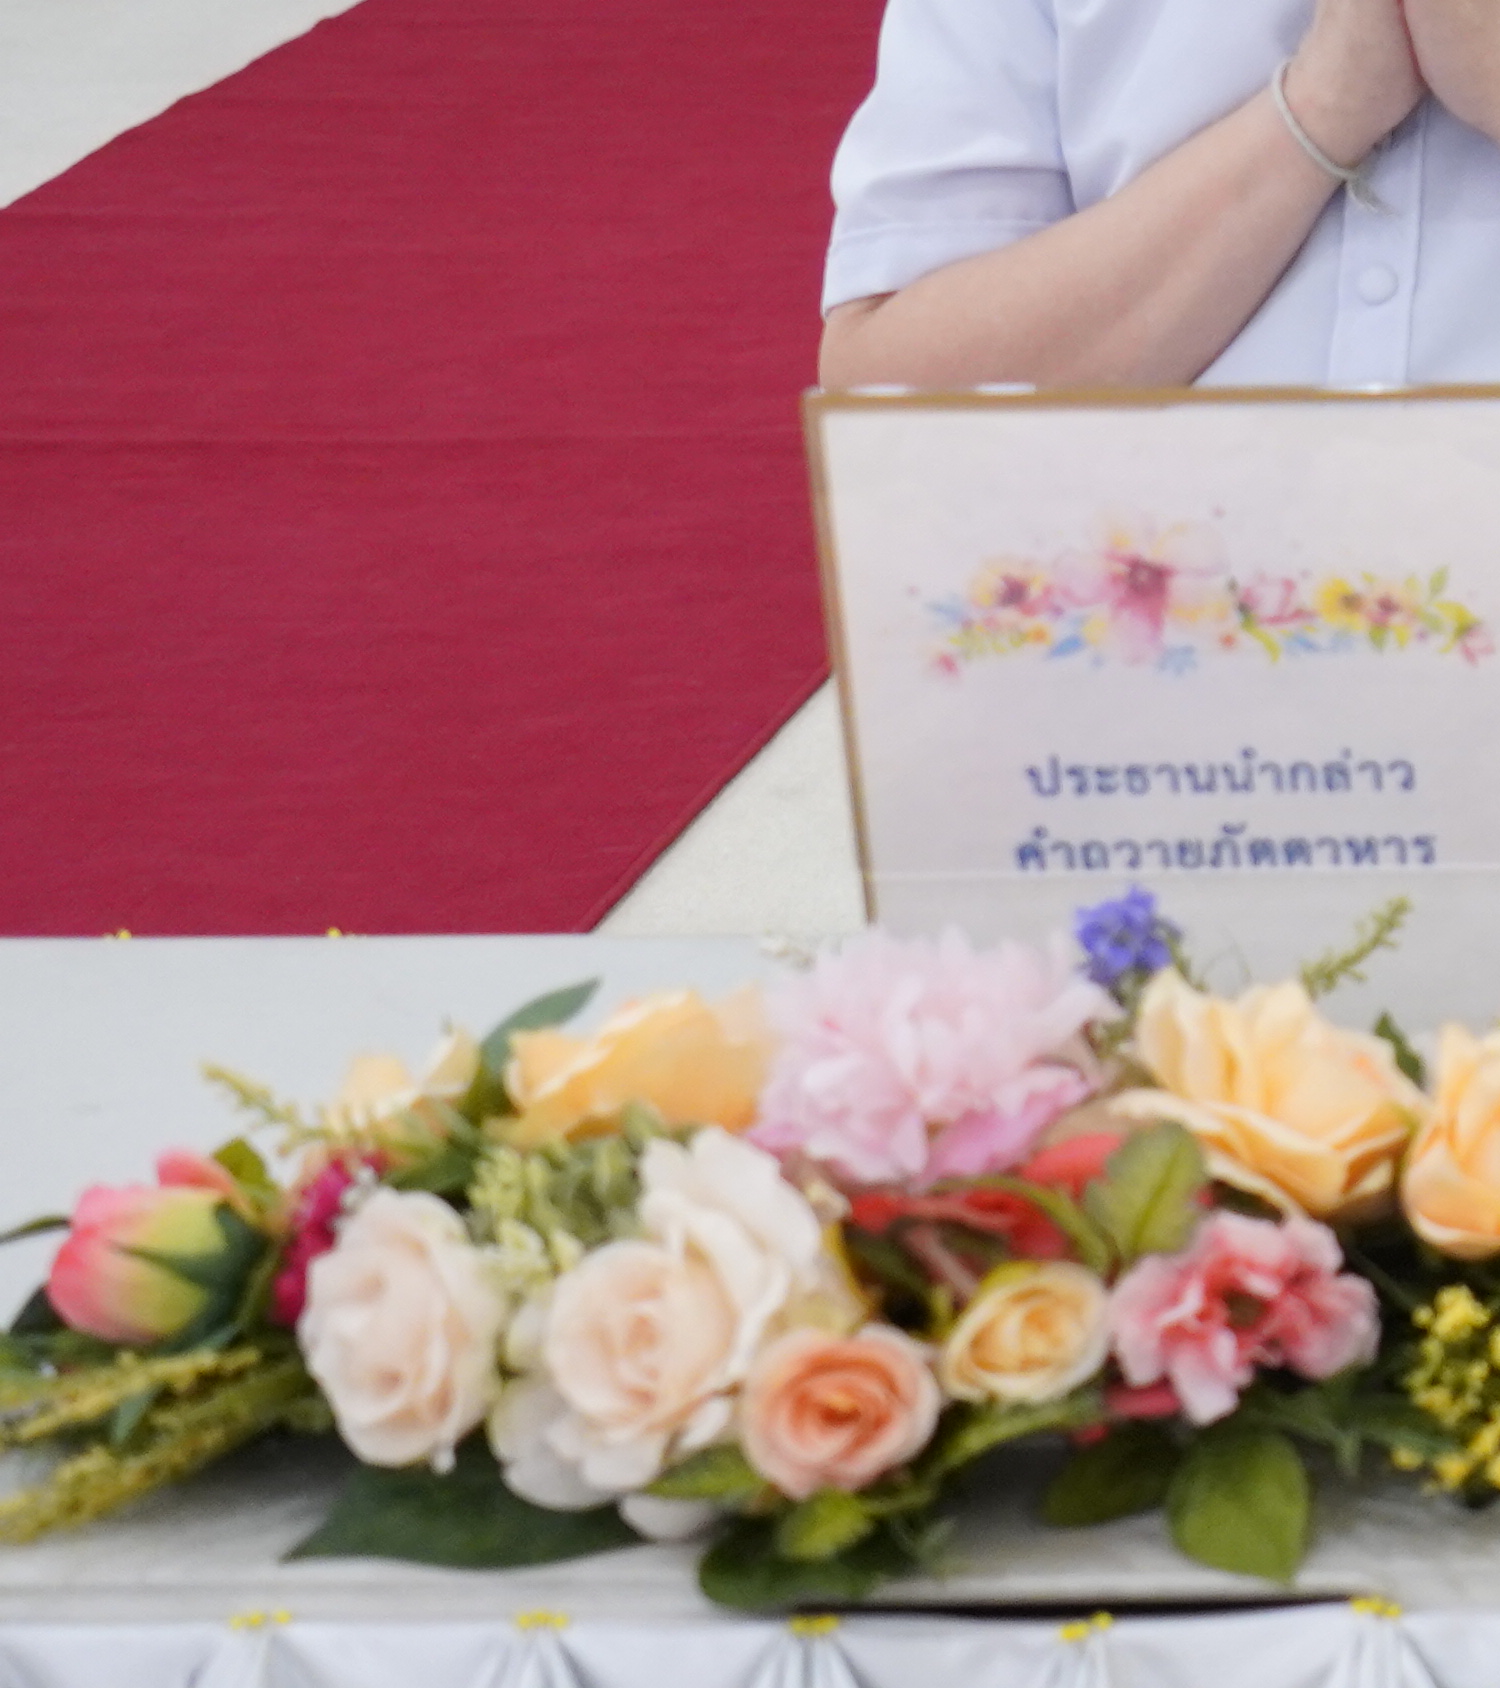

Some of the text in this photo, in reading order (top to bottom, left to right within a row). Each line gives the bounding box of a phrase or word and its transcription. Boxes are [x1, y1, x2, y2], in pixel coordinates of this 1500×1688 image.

[1025, 747, 1415, 796] ประธานนำกล่าว
[1014, 822, 1436, 870] คำถวายภัตตาหาร
